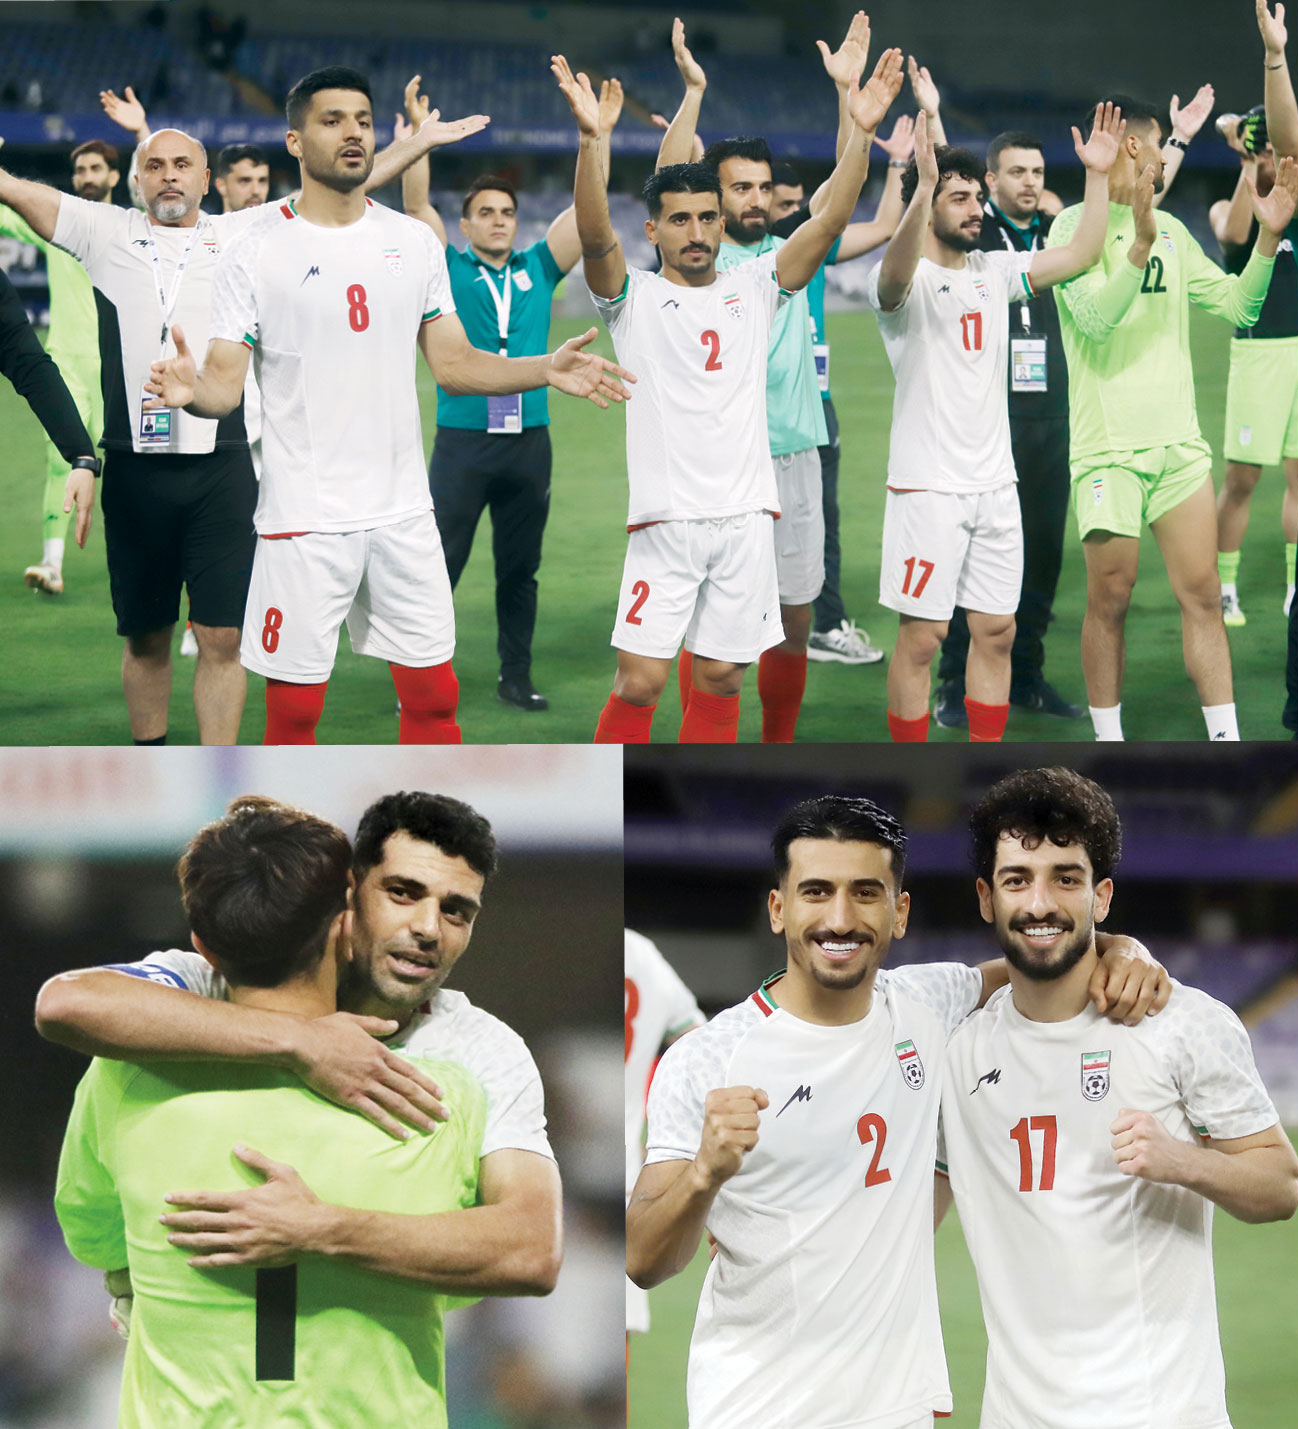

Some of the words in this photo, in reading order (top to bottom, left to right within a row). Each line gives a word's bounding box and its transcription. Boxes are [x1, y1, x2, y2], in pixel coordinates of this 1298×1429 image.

[1140, 255, 1167, 294] 22
[346, 283, 370, 333] 8
[959, 311, 983, 351] 17
[700, 330, 722, 371] 2
[902, 556, 935, 599] 17
[625, 580, 650, 626] 2
[261, 607, 283, 654] 8
[857, 1112, 891, 1188] 2
[1009, 1115, 1058, 1193] 17
